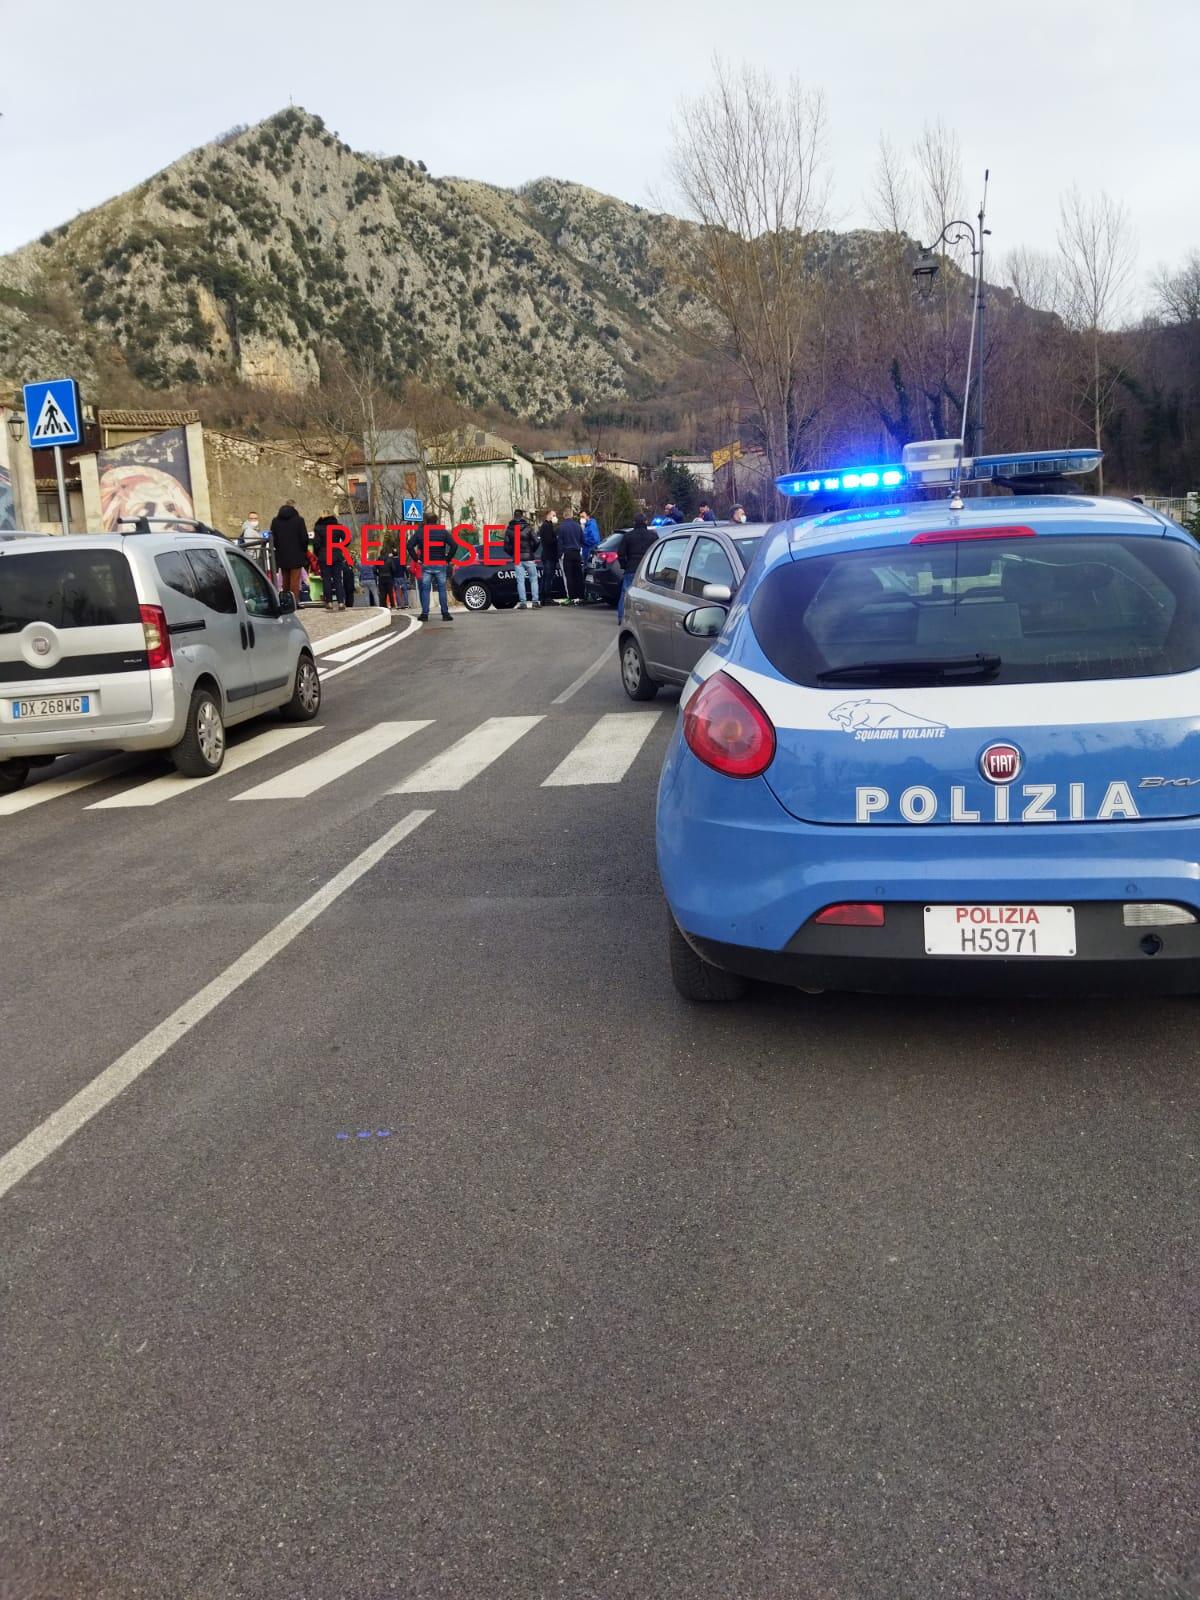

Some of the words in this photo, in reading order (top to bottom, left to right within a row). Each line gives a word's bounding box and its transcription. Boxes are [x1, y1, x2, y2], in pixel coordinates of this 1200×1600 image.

[21, 703, 35, 716] DX
[40, 699, 80, 714] 268WG
[854, 728, 899, 742] SQUADRA
[902, 727, 946, 739] VOLANTE
[990, 754, 1014, 773] FIAT
[855, 780, 1140, 823] POLIZIA
[956, 907, 1040, 924] POLIZIA
[961, 928, 1037, 953] H5971
